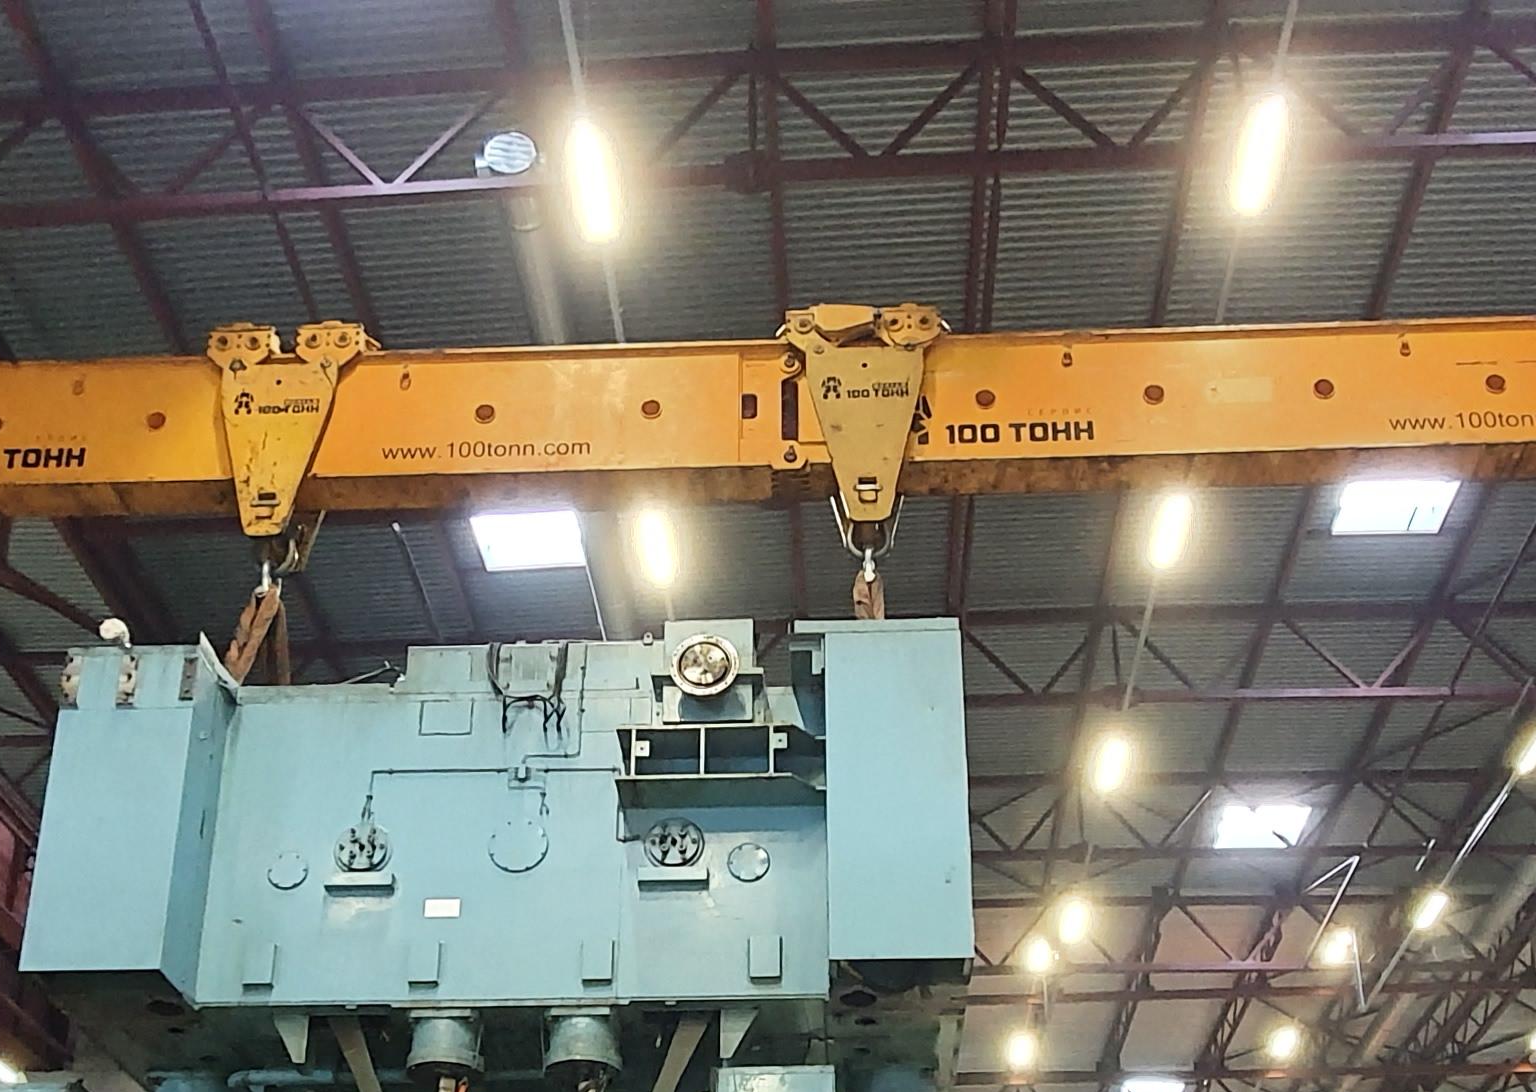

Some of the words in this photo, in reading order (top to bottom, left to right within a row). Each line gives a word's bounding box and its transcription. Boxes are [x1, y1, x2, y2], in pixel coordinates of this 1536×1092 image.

[846, 388, 871, 399] 100
[945, 423, 1001, 444] 100
[1008, 420, 1095, 443] ТОНН
[4, 447, 86, 470] ТОНН
[381, 440, 592, 460] www.100tonn.com
